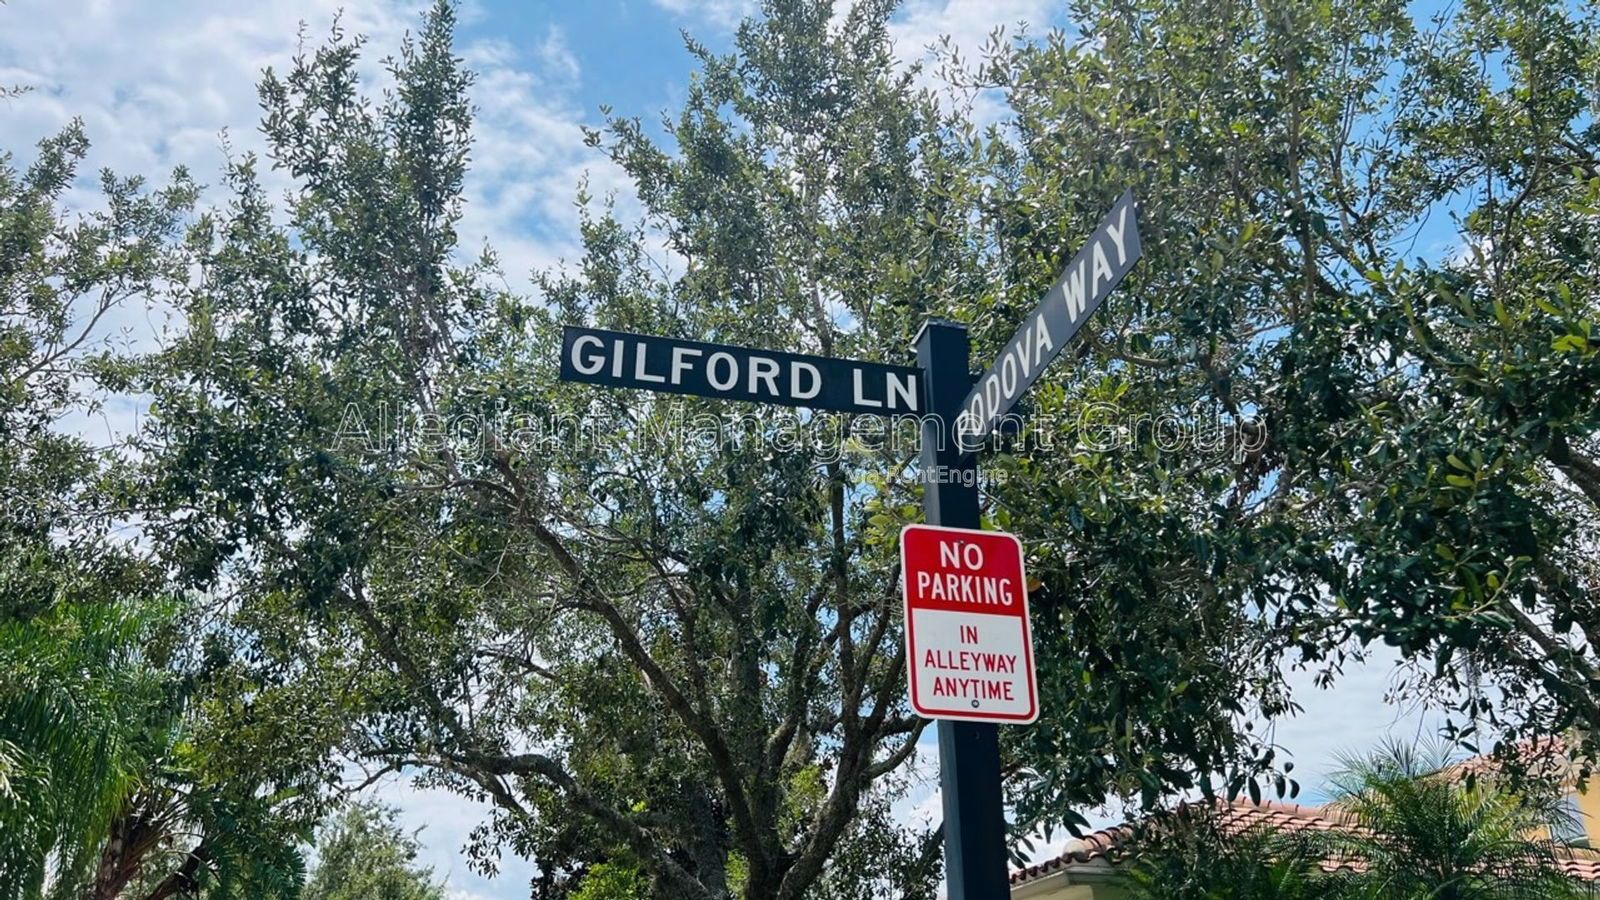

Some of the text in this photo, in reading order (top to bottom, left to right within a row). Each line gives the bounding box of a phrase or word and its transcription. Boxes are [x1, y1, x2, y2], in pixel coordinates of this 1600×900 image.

[957, 206, 1127, 456] PODOVA WAY
[571, 335, 918, 411] GILFORD LN
[939, 541, 984, 571] NO
[917, 571, 1013, 606] PARKING
[959, 625, 978, 645] IN
[924, 649, 1017, 674] ALLEYWAY
[933, 676, 1015, 700] ANYTIME
